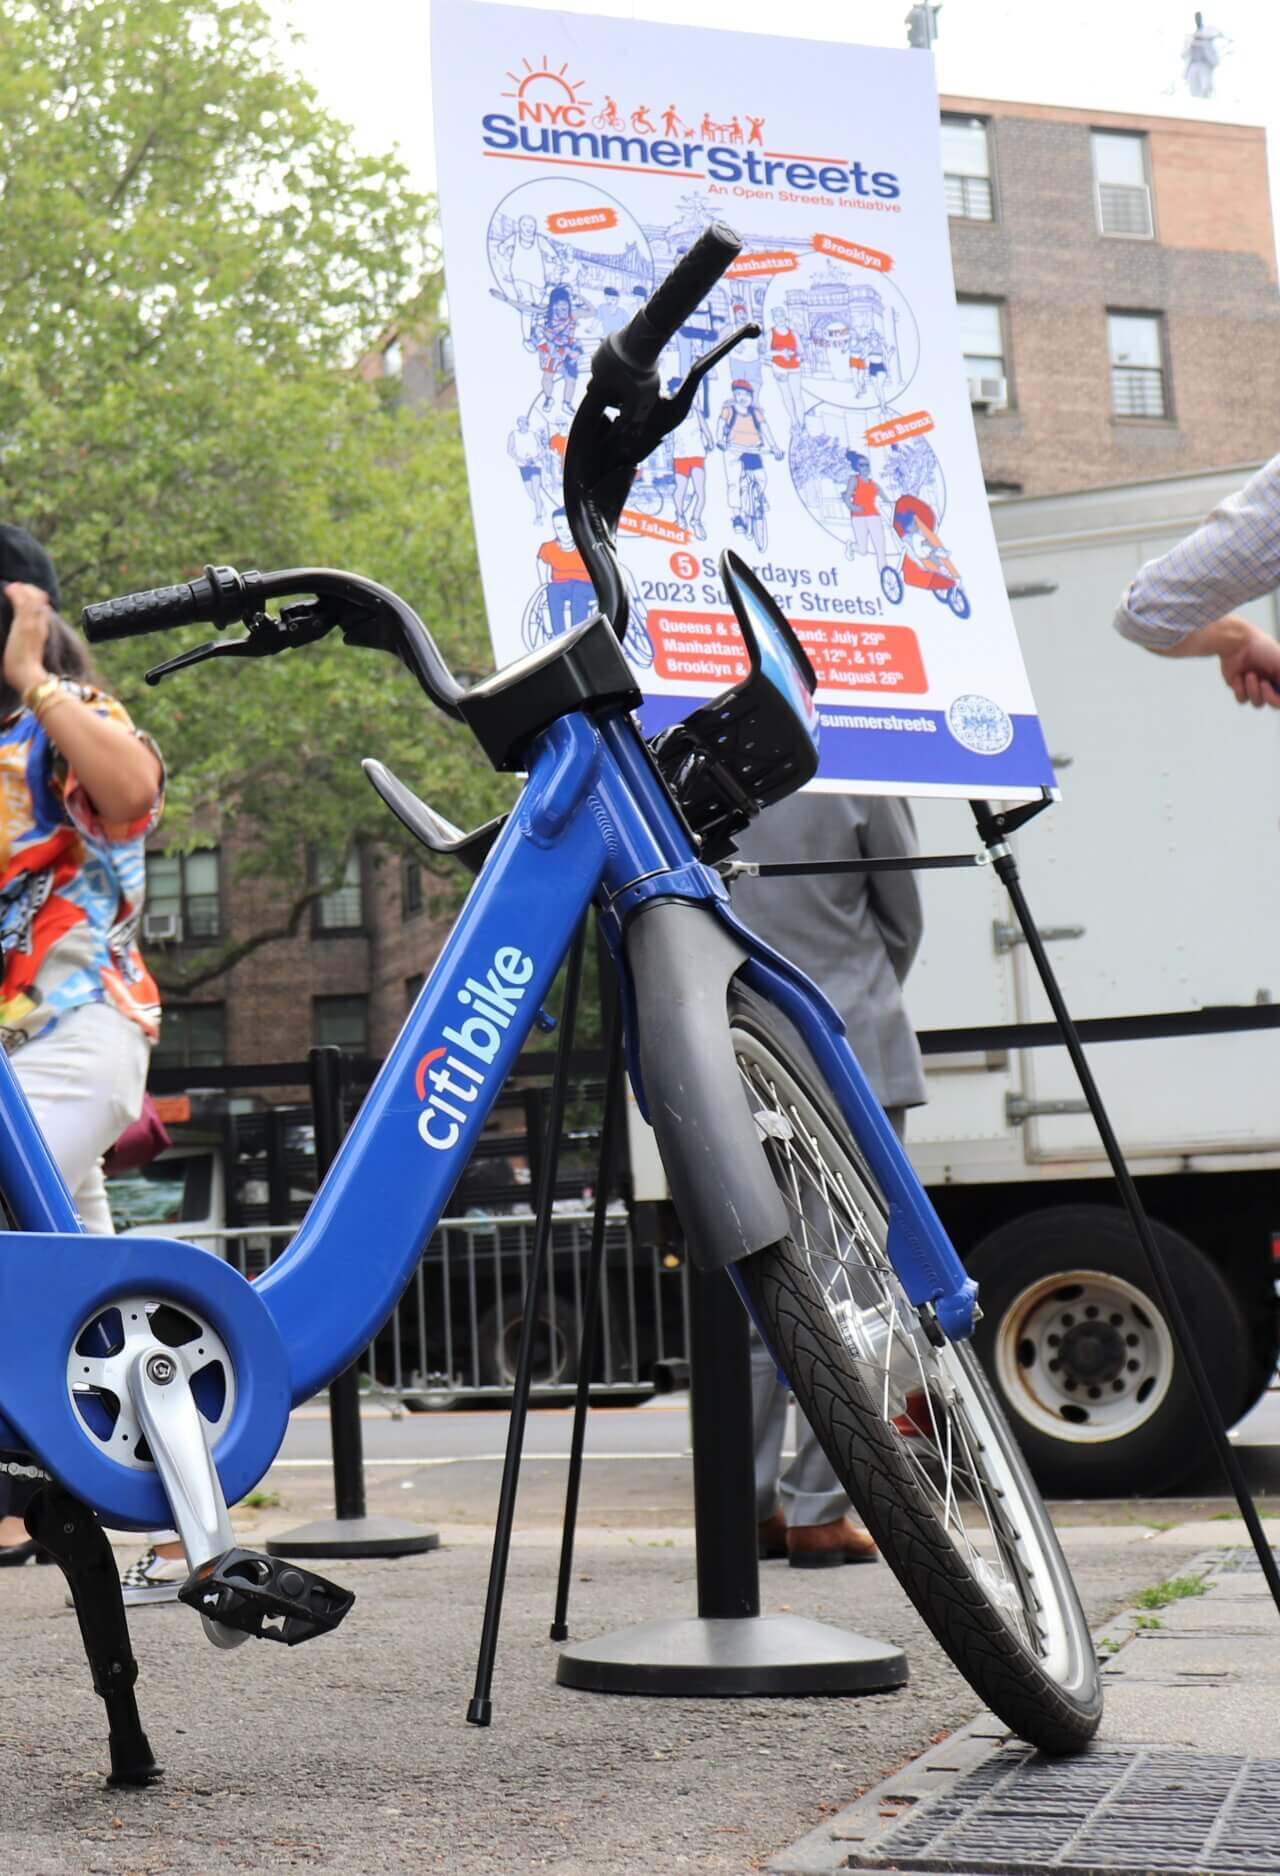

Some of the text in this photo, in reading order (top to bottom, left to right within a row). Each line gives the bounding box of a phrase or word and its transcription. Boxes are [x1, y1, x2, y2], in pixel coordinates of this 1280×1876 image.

[518, 101, 586, 128] NYC
[708, 184, 901, 213] An Open Streets Initiative
[556, 213, 607, 229] Queens
[822, 238, 881, 267] Brooklyn
[870, 415, 932, 442] The Bronx
[640, 520, 685, 541] Island
[677, 555, 694, 577] 5
[819, 566, 839, 587] of
[641, 580, 696, 604] 2023
[800, 591, 884, 616] Streets!
[658, 618, 713, 635] Queens
[716, 622, 728, 637] &
[831, 630, 859, 646] July
[861, 632, 886, 646] 29th
[663, 638, 746, 657] Manhattan:
[854, 650, 865, 664] &
[868, 651, 892, 665] 19th
[666, 658, 732, 677] Brooklyn
[735, 662, 748, 677] &
[829, 669, 878, 686] August
[880, 671, 904, 686] 26th
[416, 946, 535, 1151] citi bike
